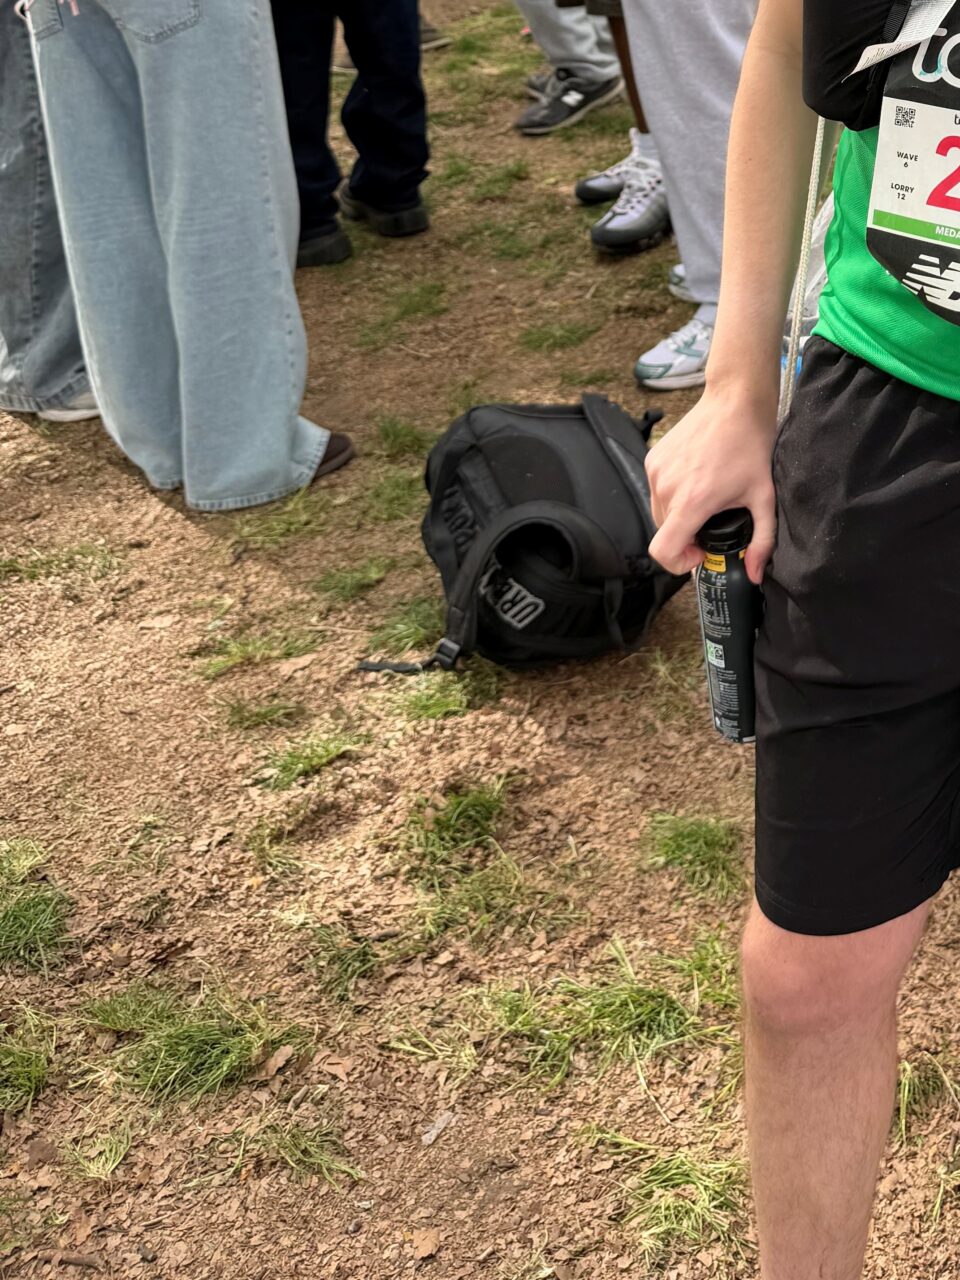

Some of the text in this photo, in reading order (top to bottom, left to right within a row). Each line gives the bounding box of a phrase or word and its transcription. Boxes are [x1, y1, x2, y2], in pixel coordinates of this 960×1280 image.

[896, 151, 919, 162] WAVE
[890, 182, 915, 194] LORRY
[897, 192, 906, 200] 12
